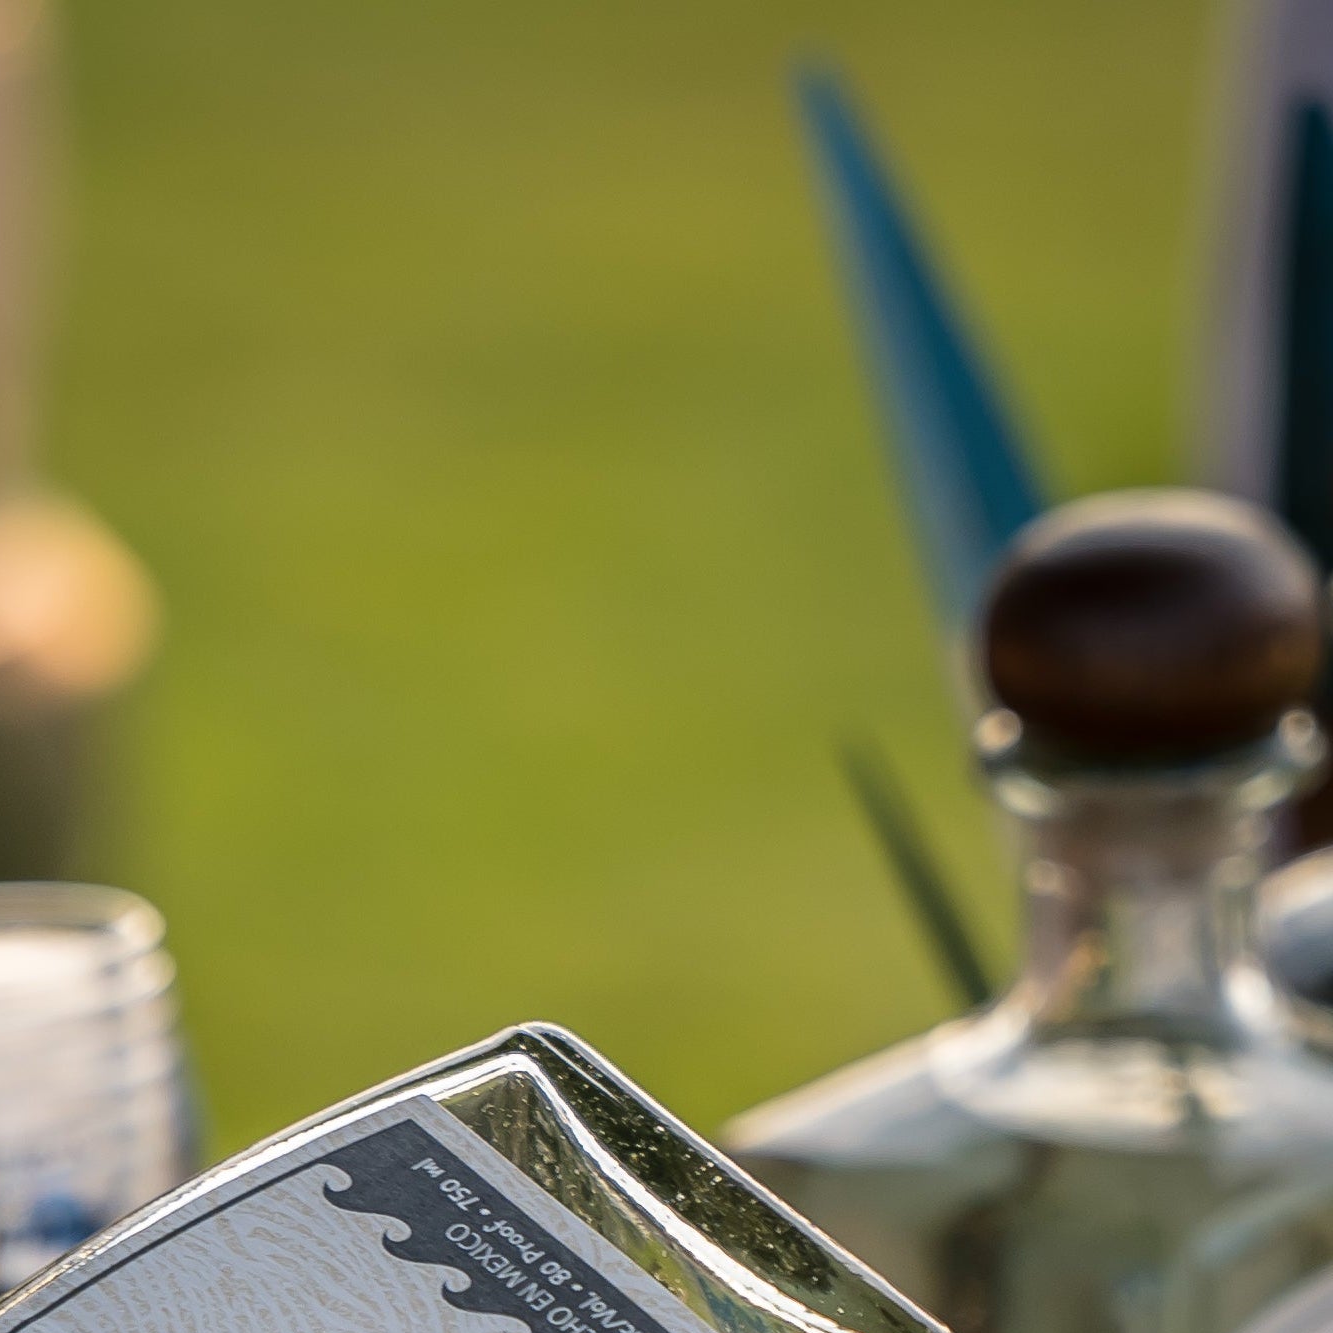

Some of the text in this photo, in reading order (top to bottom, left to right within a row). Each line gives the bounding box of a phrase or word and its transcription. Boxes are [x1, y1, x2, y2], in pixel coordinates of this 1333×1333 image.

[410, 1157, 446, 1178] ml
[439, 1179, 480, 1212] 750
[444, 1223, 528, 1289] MEXICO
[483, 1219, 545, 1265] Proof
[539, 1261, 572, 1286] 80
[516, 1282, 556, 1312] EN
